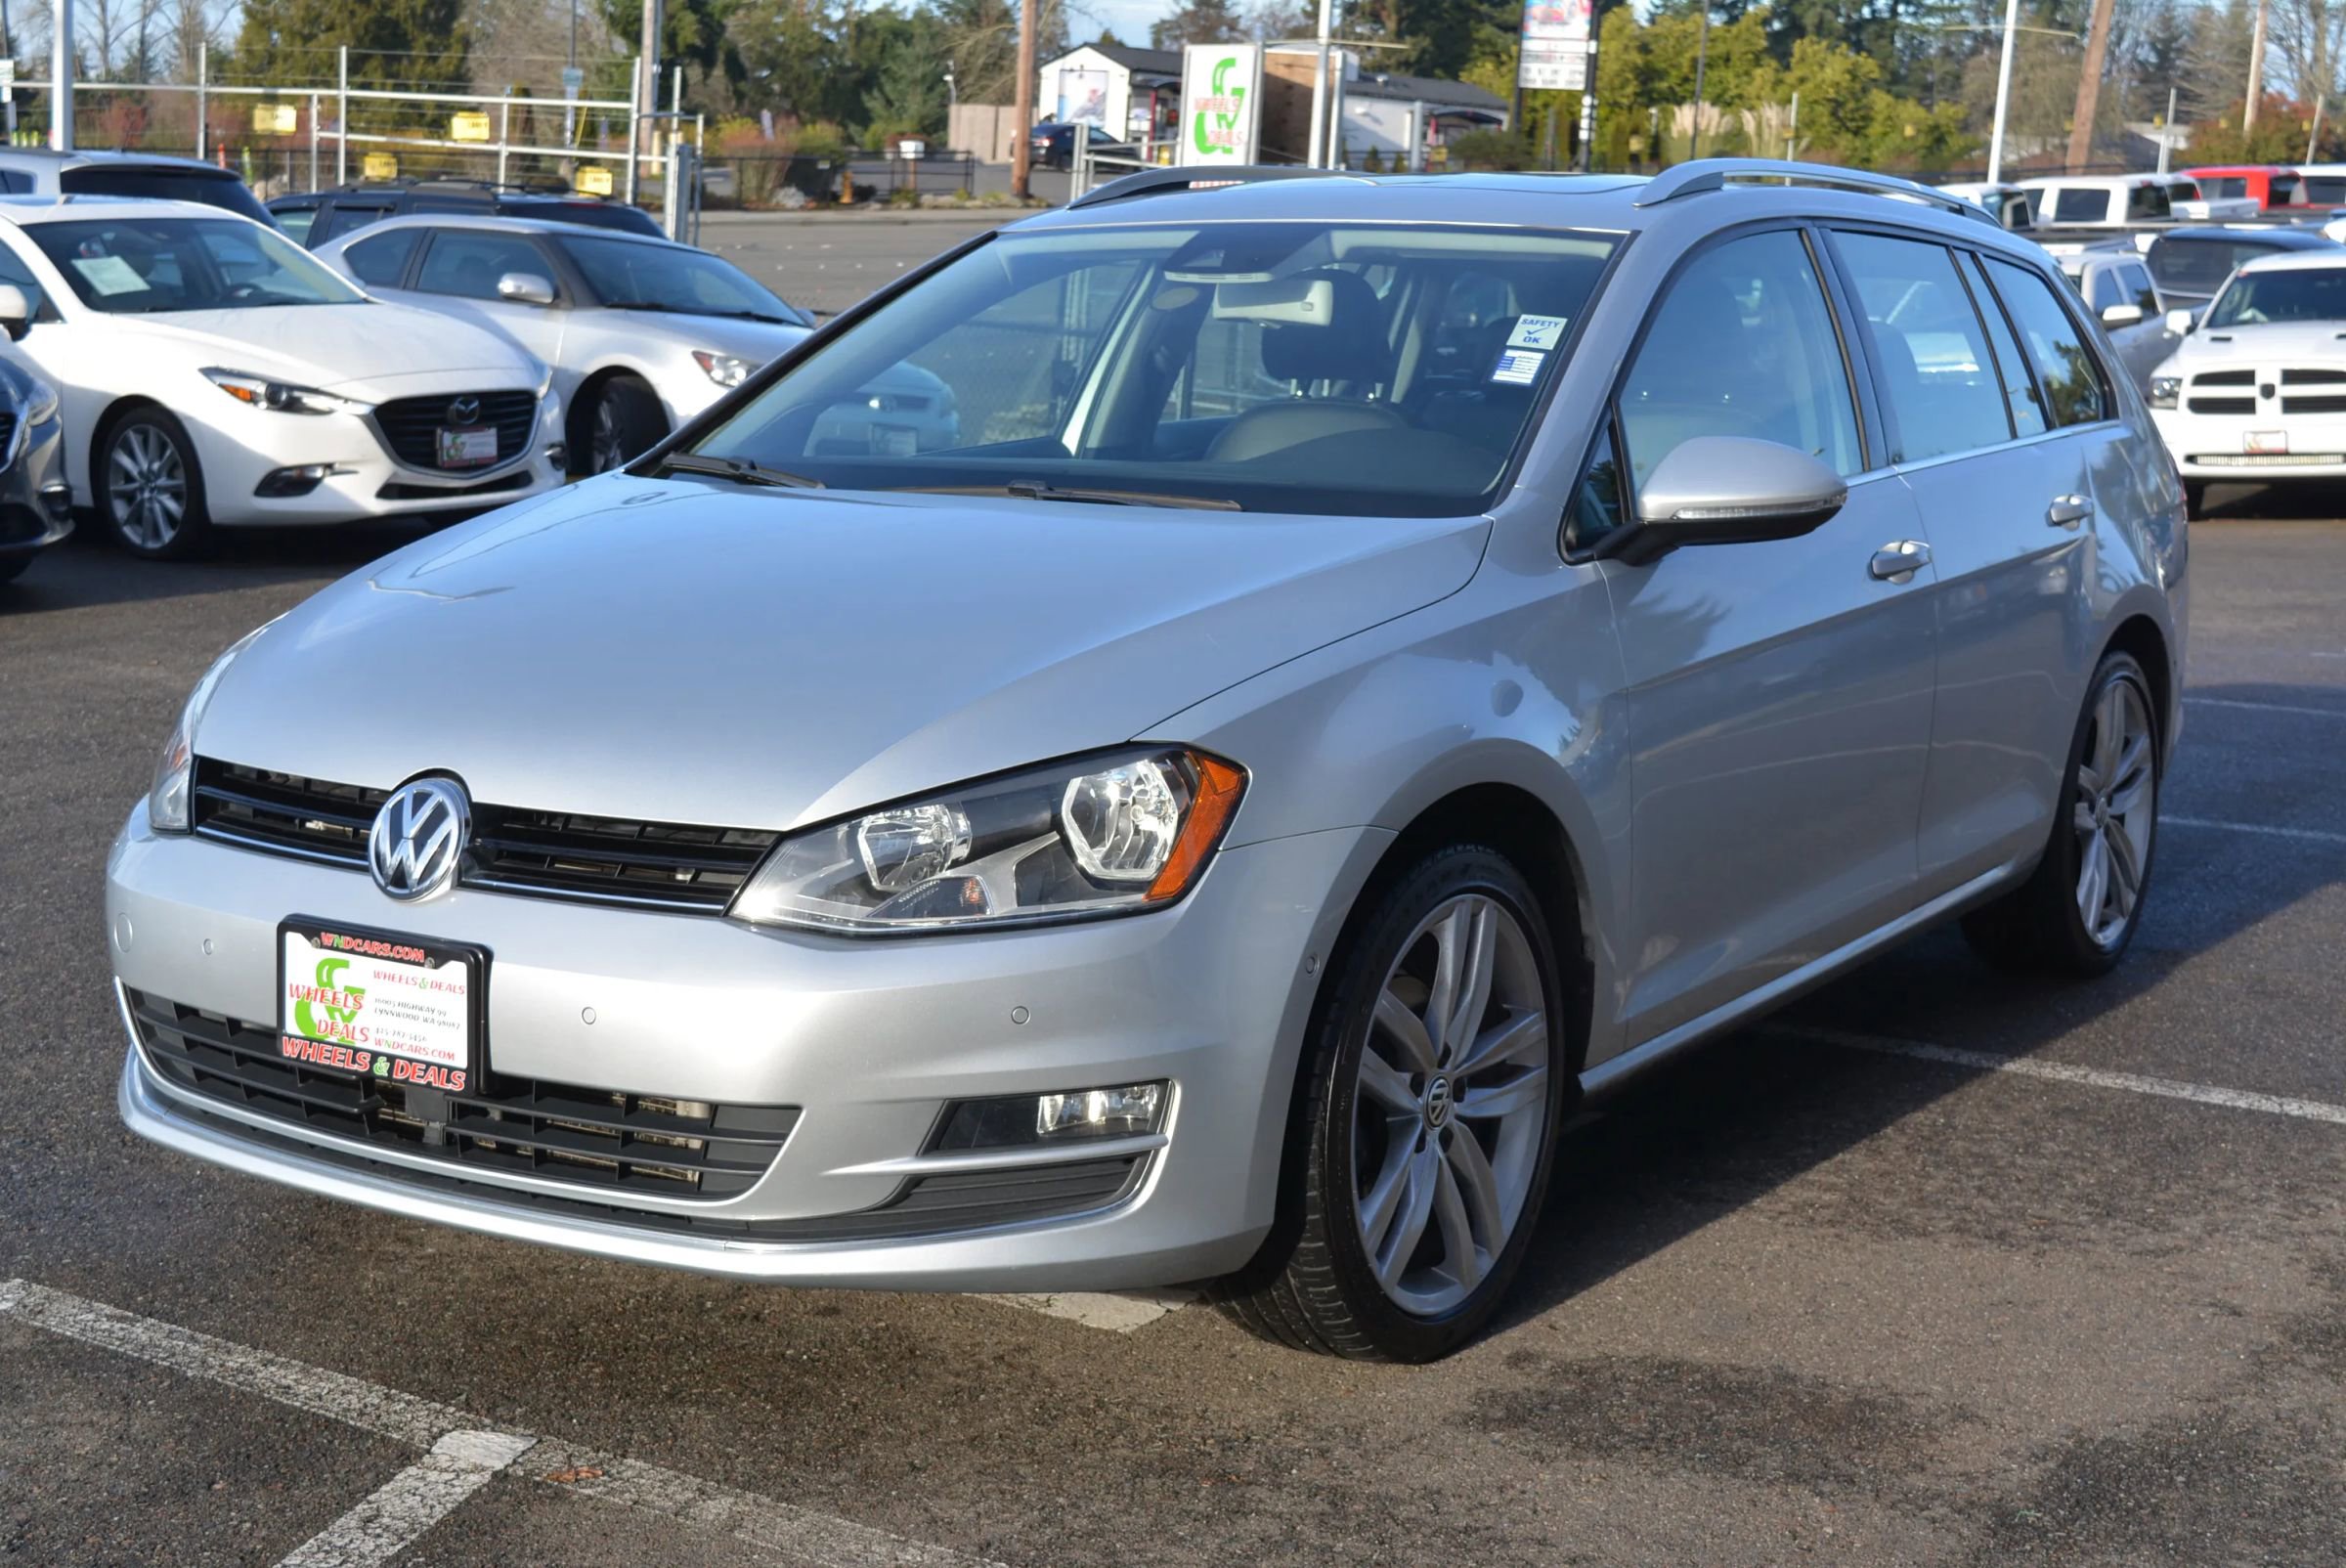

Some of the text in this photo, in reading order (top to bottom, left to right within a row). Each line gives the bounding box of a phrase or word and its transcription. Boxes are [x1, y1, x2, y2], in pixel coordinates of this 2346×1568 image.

[1521, 318, 1560, 328] SAFETY
[1523, 335, 1542, 344] OK
[321, 932, 425, 963] WNDCARS.COM
[288, 982, 365, 1011] WHEELS
[374, 1007, 420, 1023] LYNNWOOD
[422, 1016, 436, 1024] WA
[397, 1001, 436, 1015] HIGHWAY
[316, 1019, 370, 1043] DEALS
[282, 1035, 467, 1092] WHEELS & DEALS
